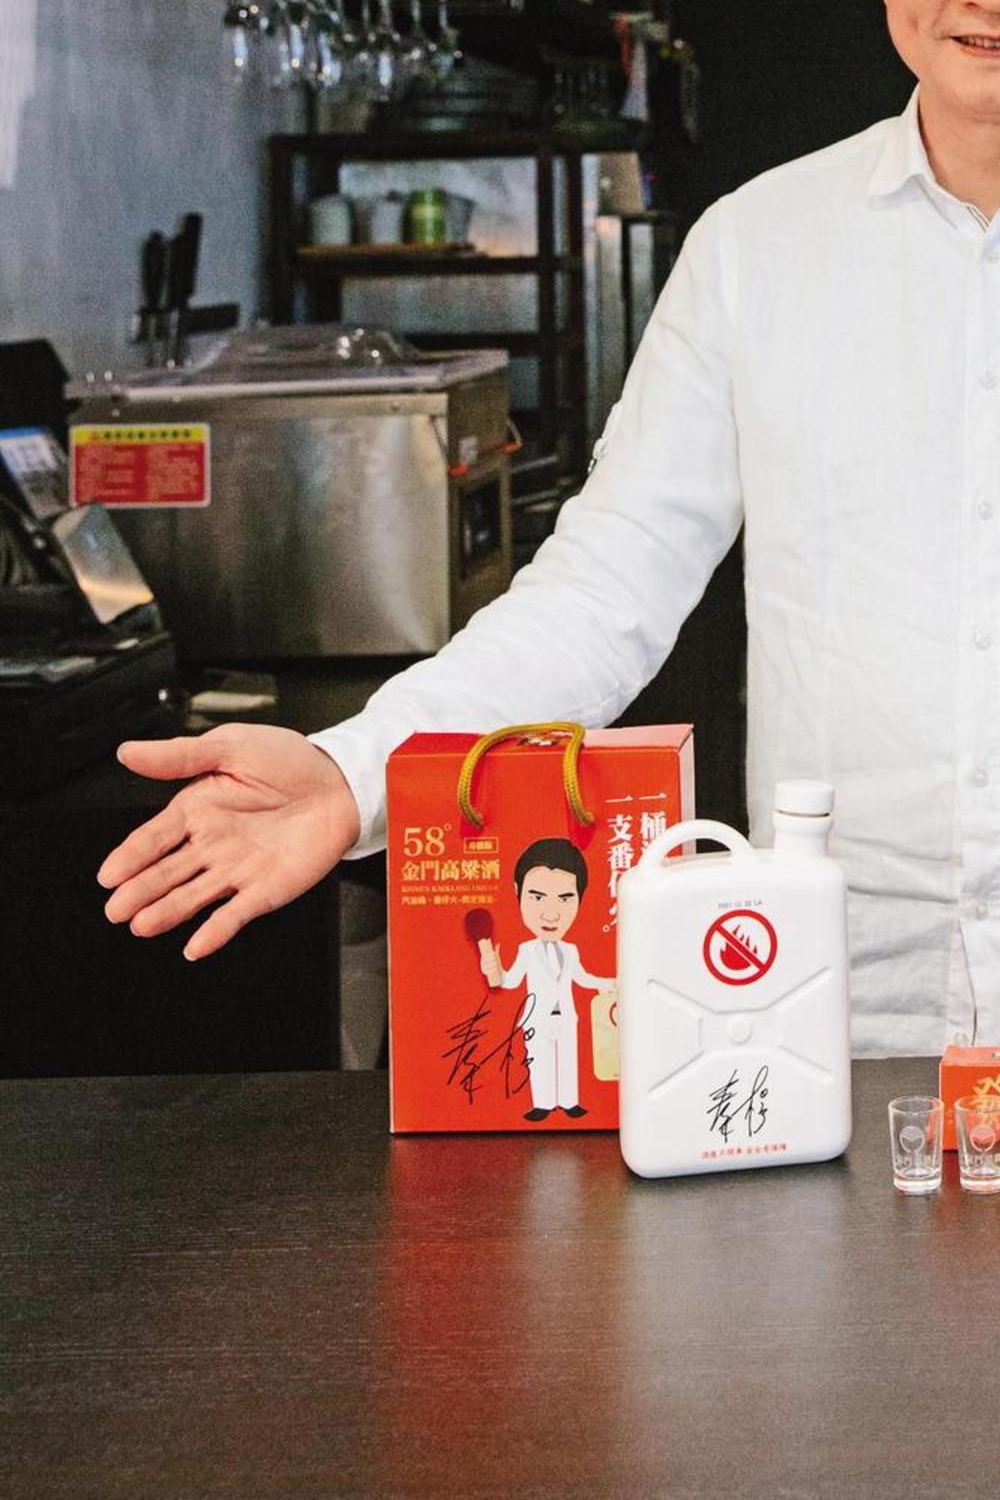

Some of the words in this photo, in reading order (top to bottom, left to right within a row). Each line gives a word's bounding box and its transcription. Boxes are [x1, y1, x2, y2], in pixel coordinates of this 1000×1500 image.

[401, 859, 500, 881] 金門高粱酒
